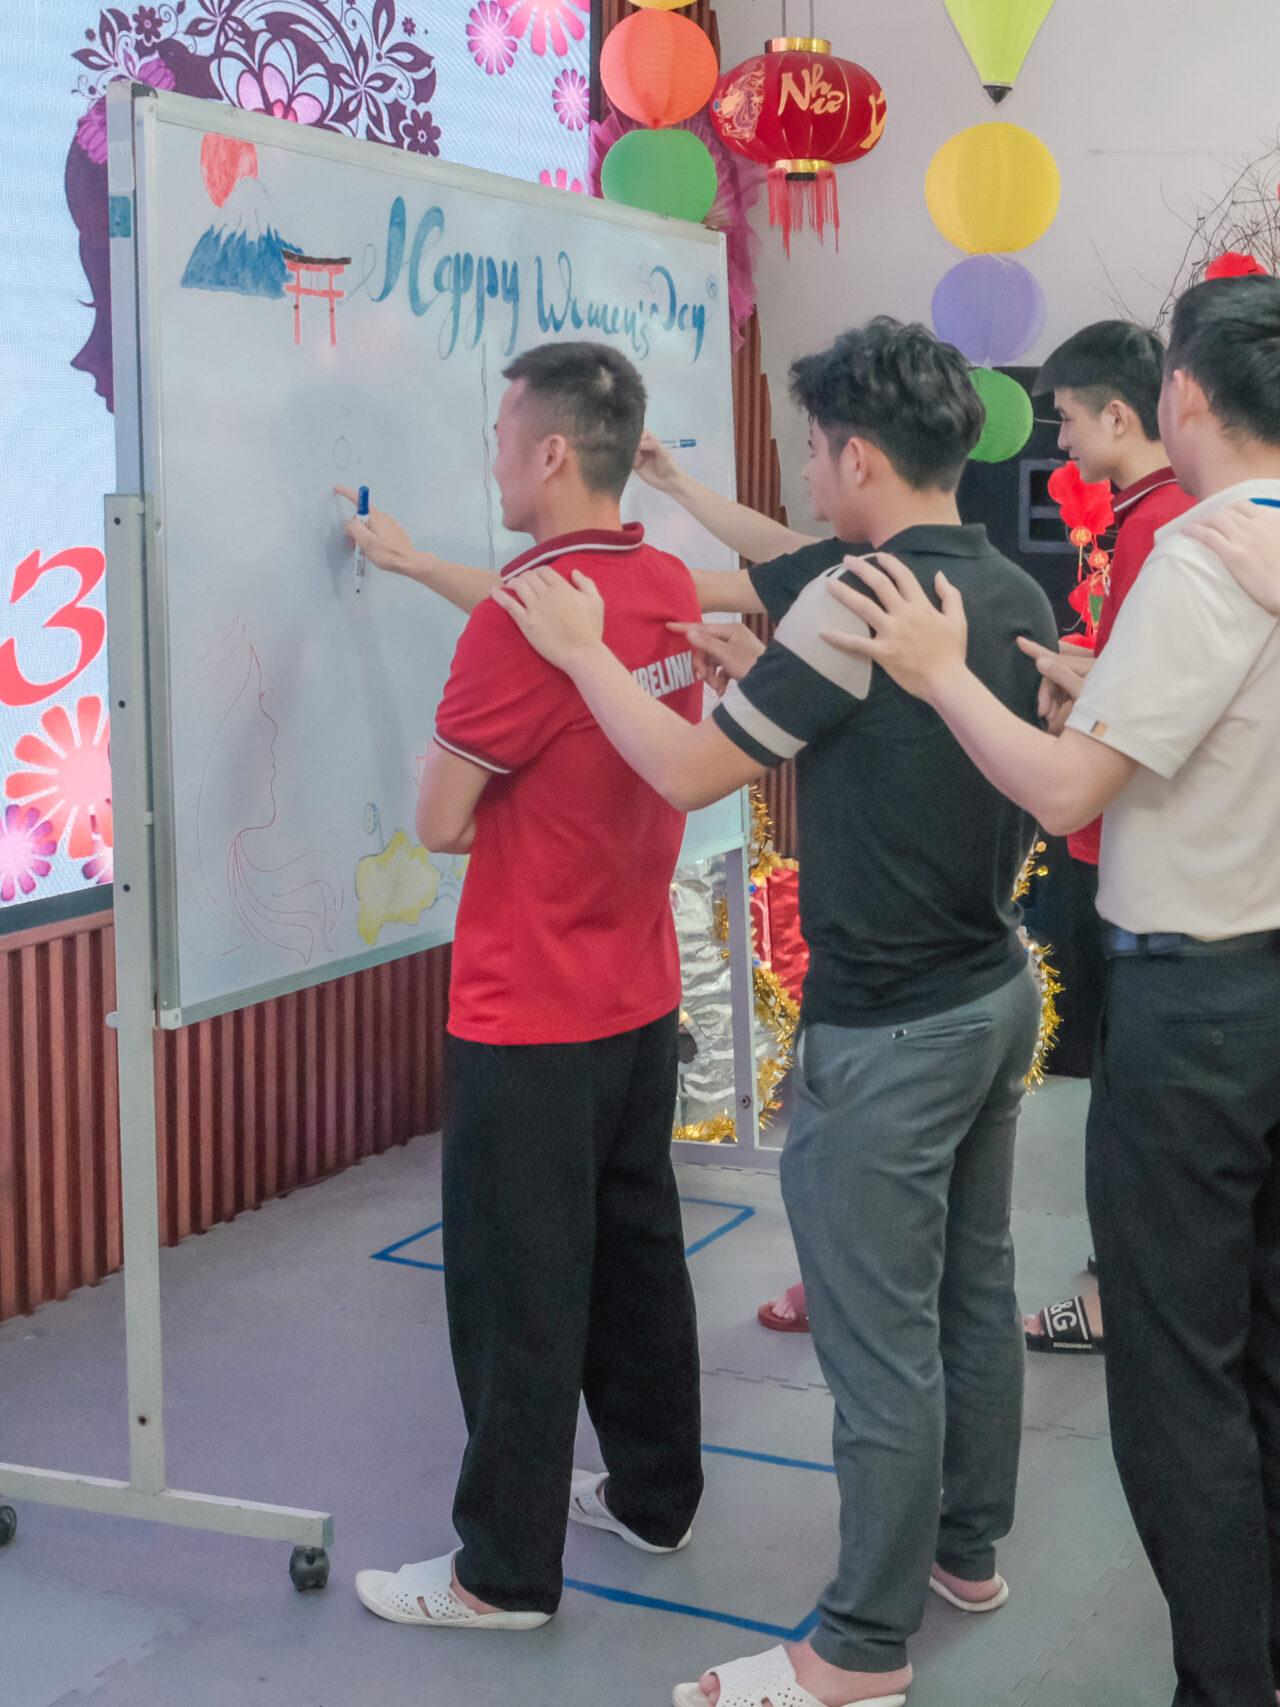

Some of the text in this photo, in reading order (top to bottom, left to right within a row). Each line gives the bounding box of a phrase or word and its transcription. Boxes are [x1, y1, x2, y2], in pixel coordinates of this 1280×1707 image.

[365, 195, 706, 365] Happy Women's Day
[0, 546, 107, 707] 3
[1050, 1301, 1077, 1332] &G
